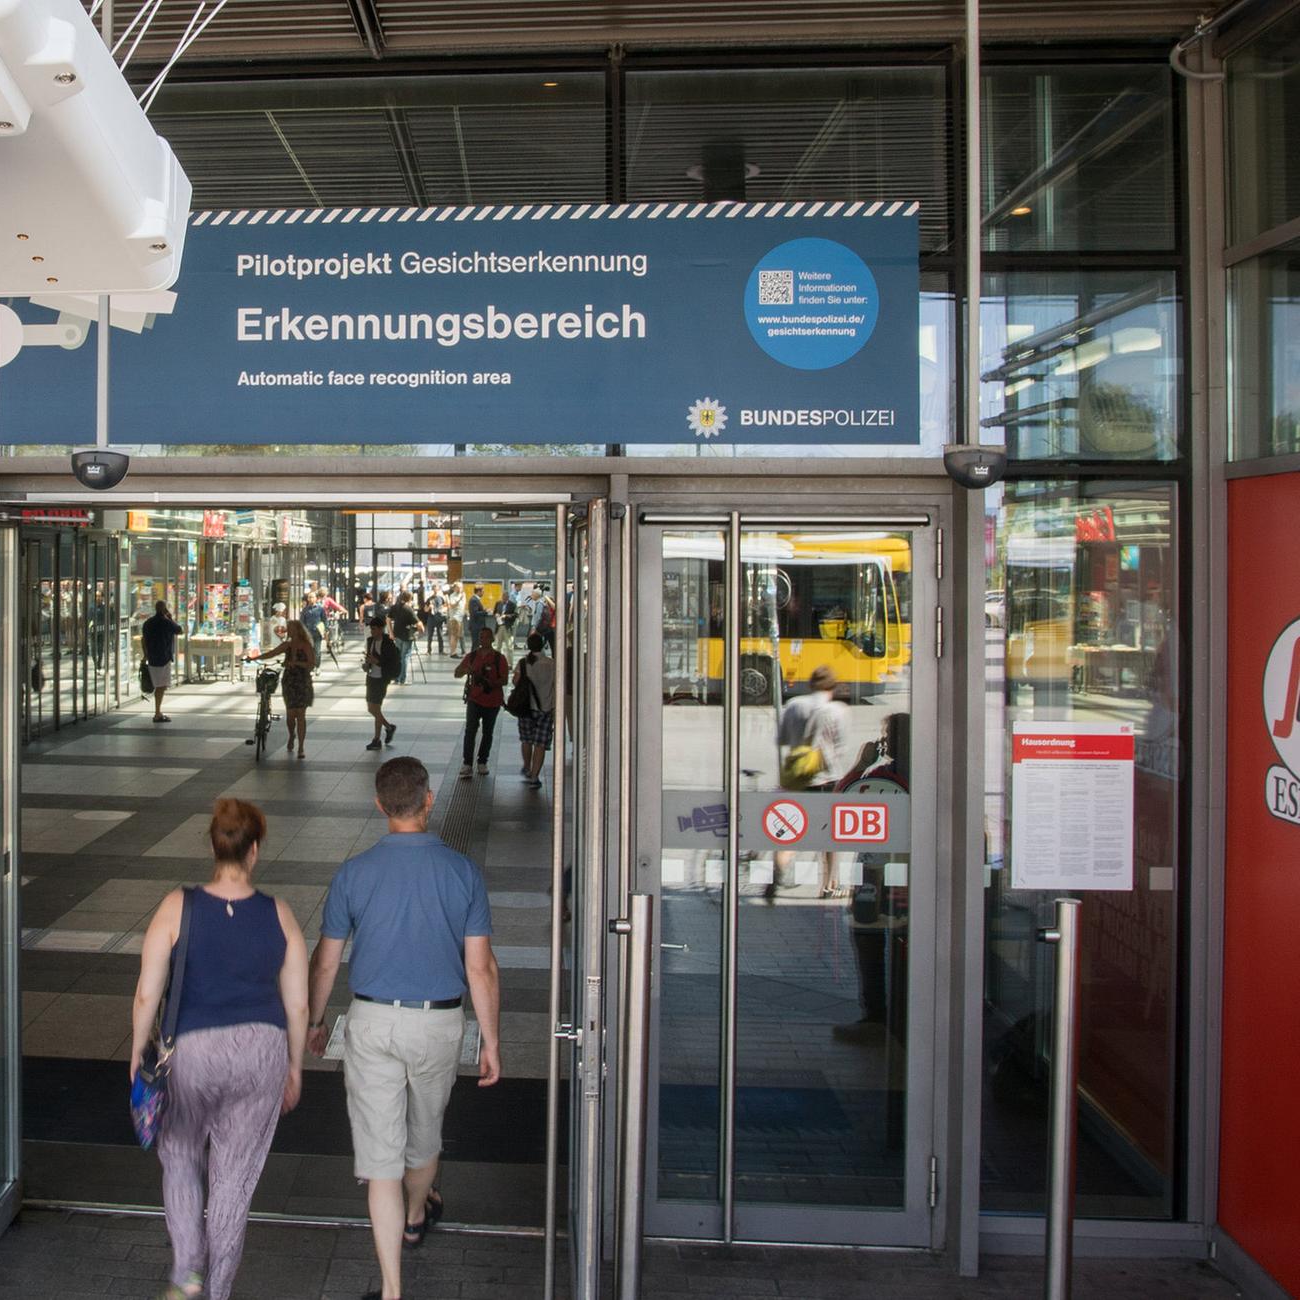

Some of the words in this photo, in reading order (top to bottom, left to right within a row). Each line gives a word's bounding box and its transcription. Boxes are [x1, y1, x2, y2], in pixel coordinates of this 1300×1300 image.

[237, 252, 392, 280] Pilotprojekt
[400, 250, 648, 277] Gesichtserkennung
[798, 271, 832, 281] Weitere
[798, 283, 857, 293] Informationen
[798, 295, 825, 305] finden
[827, 295, 842, 305] Sie
[843, 295, 869, 305] unter:
[236, 305, 647, 347] Erkennungsbereich
[757, 314, 865, 326] www.bundespolizei.de/
[767, 326, 856, 337] gesichtserkennung
[237, 370, 324, 386] Automatic
[327, 370, 365, 386] face
[369, 369, 468, 388] recognition
[472, 372, 512, 386] area
[740, 409, 895, 427] BUNDESPOLIZEI
[1021, 737, 1076, 748] Hausordnung
[1272, 775, 1300, 821] ES
[838, 808, 883, 837] DB
